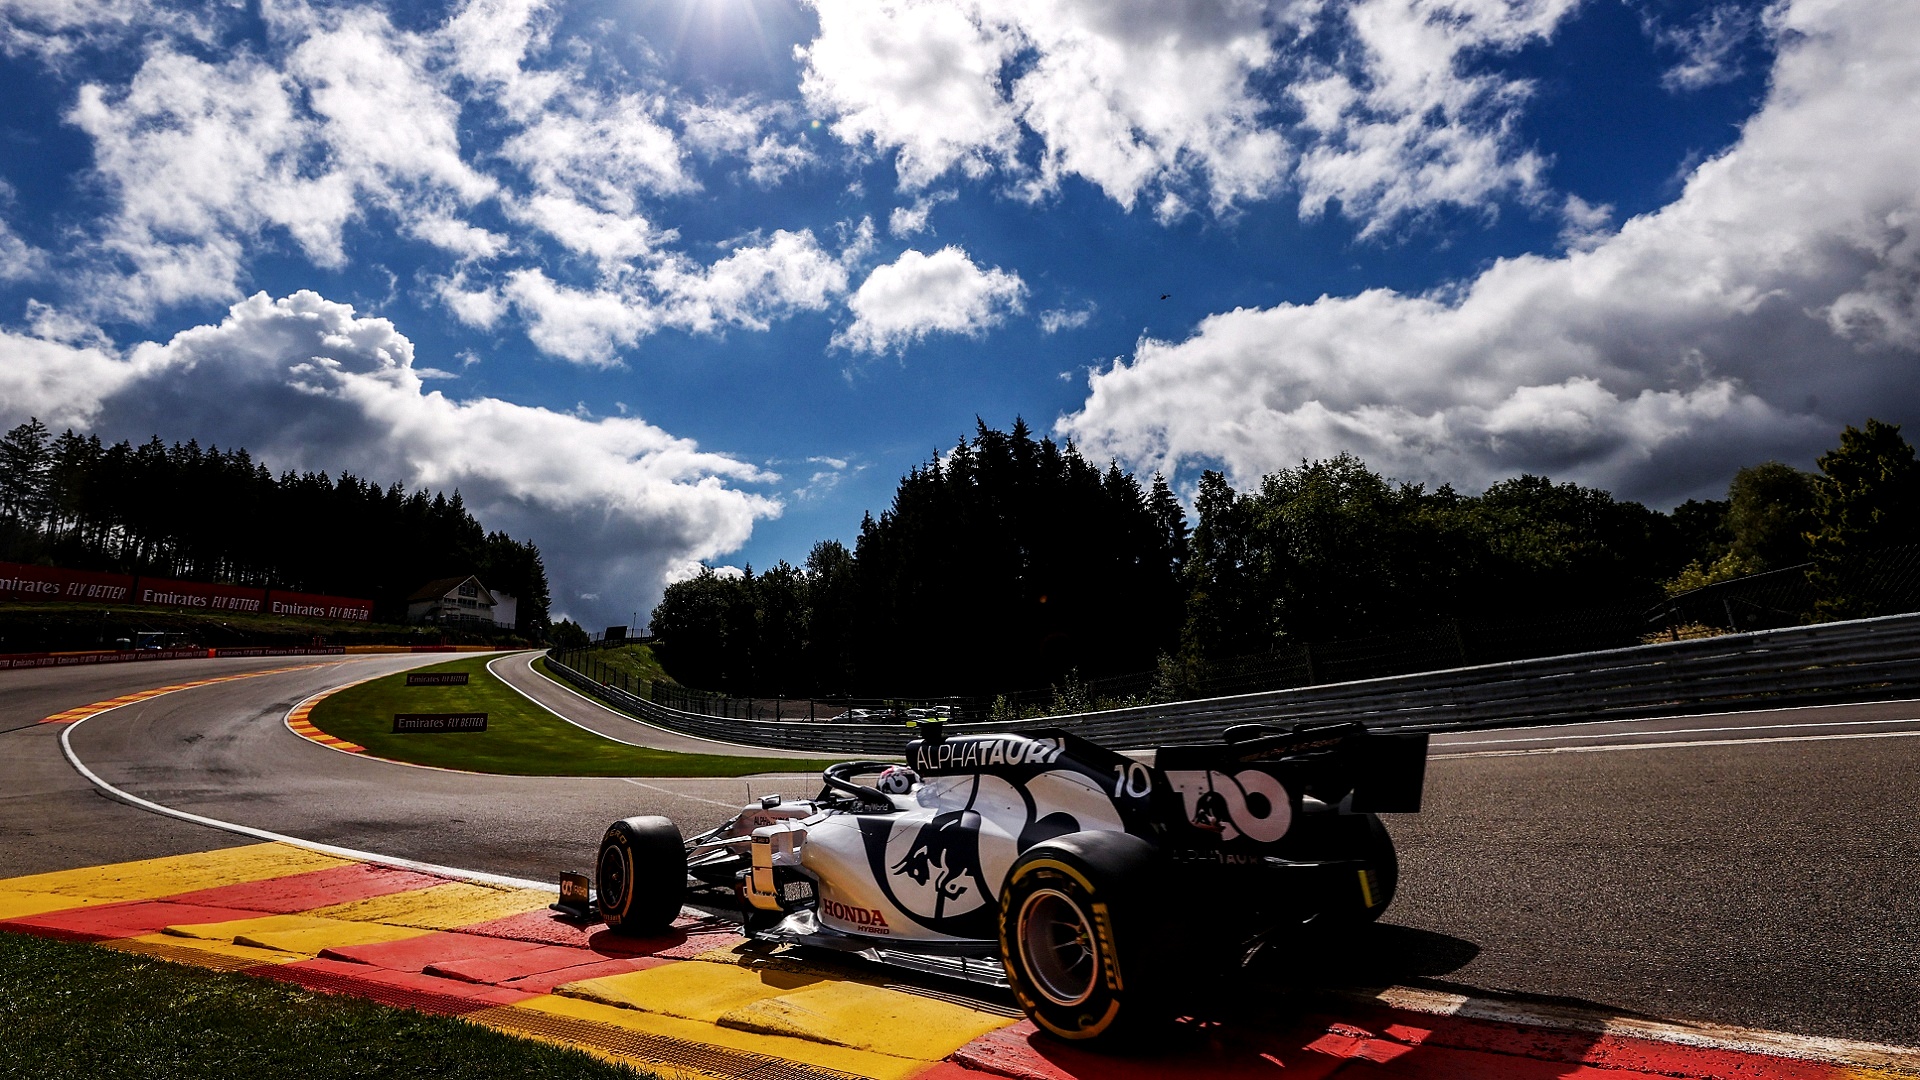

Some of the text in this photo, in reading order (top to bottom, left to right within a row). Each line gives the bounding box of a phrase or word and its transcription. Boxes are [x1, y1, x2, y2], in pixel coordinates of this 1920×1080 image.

[66, 582, 87, 596] FLY
[87, 584, 127, 600] BETTER
[143, 589, 260, 611] Emirates FLY BETTER
[272, 601, 325, 616] Emirates
[409, 675, 440, 683] Emirates
[398, 717, 484, 728] Emirates FLY BETTER
[916, 737, 1066, 771] ALPHATAURI
[1113, 761, 1153, 799] 10
[823, 898, 889, 927] HONDA
[858, 925, 890, 935] HYBRID
